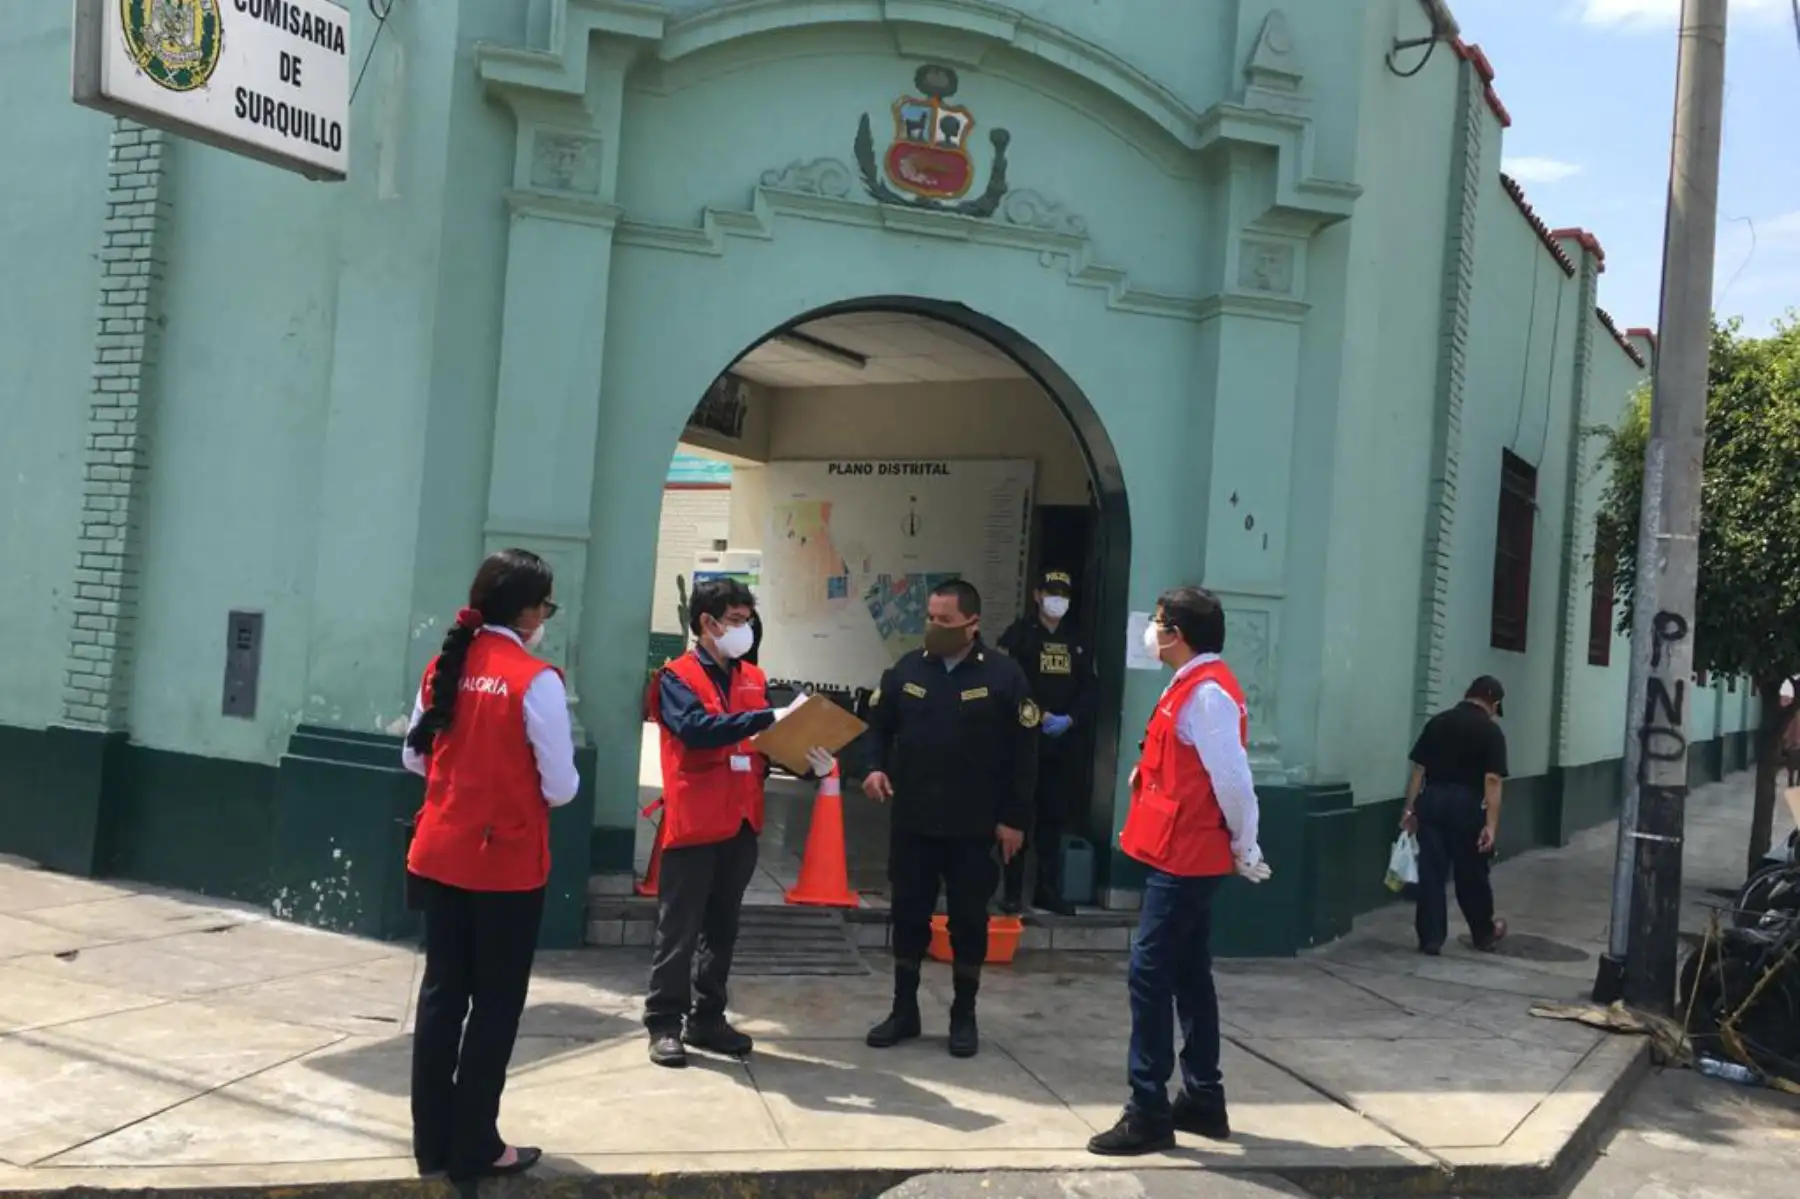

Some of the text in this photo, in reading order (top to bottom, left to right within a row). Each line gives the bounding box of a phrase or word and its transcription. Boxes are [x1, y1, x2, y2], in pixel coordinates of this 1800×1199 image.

[278, 51, 302, 87] DE
[234, 86, 342, 152] SURQUILLO
[828, 462, 951, 476] PLANO DISTRITAL
